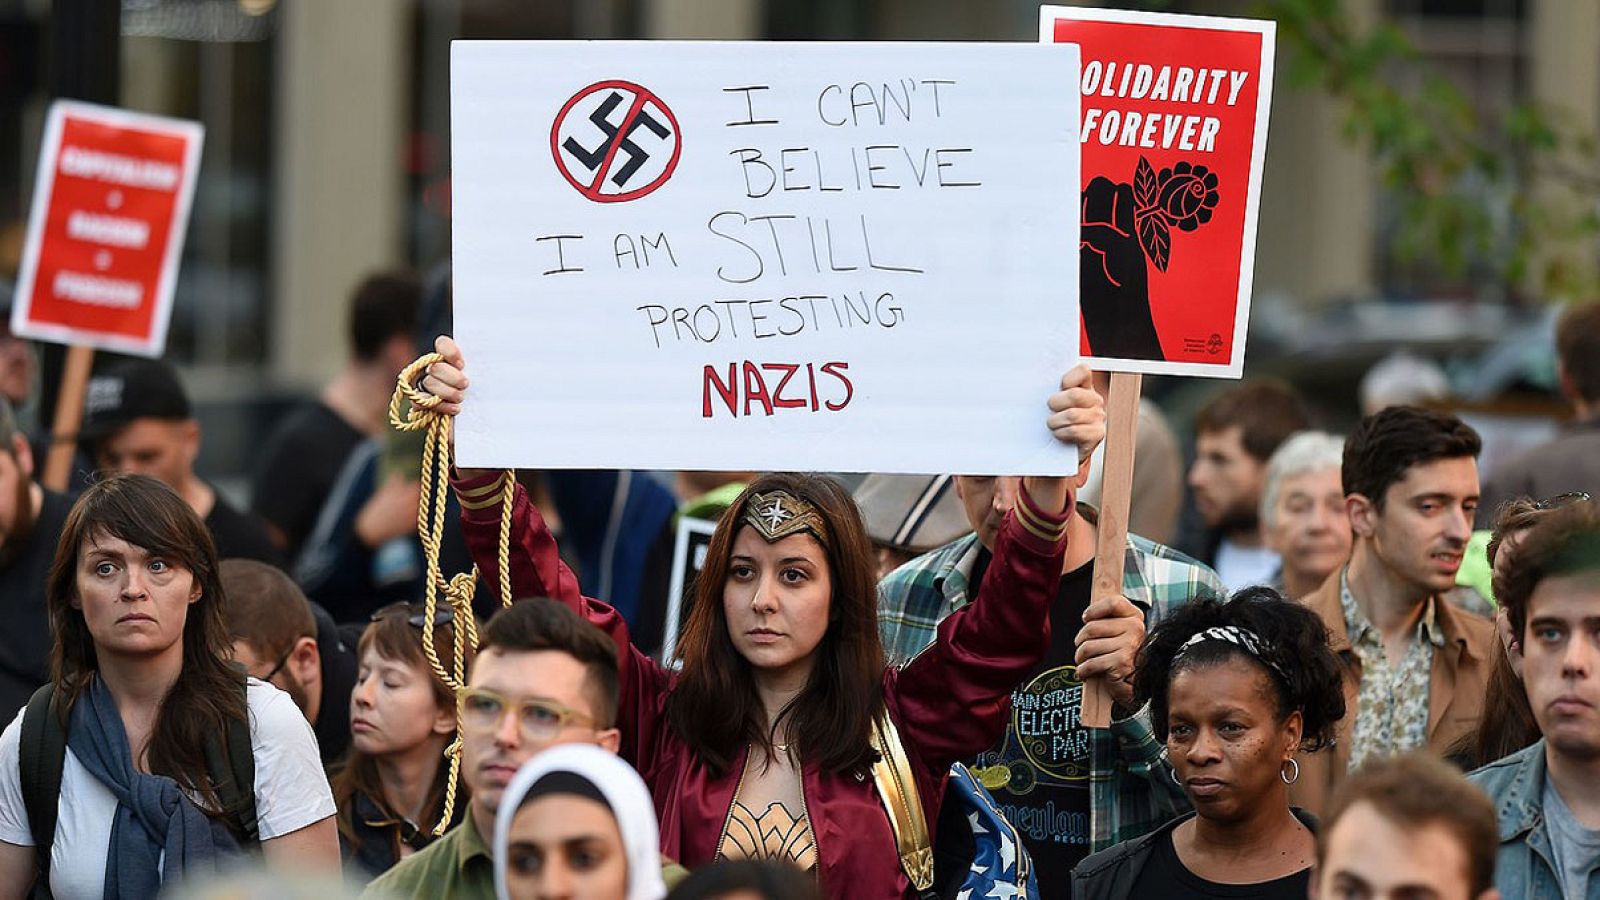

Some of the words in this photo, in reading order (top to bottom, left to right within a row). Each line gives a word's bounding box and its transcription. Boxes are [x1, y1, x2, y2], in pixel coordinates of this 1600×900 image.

[722, 85, 779, 127] I
[818, 79, 956, 127] CAN'T
[1080, 60, 1249, 106] OLIDARITY
[1080, 108, 1221, 152] FOREVER
[729, 146, 982, 198] BELIEVE
[535, 234, 584, 276] I
[613, 232, 678, 269] AM
[708, 211, 924, 283] STILL
[636, 292, 905, 348] PROTESTING
[702, 360, 854, 419] NAZIS
[1041, 686, 1083, 708] STREE
